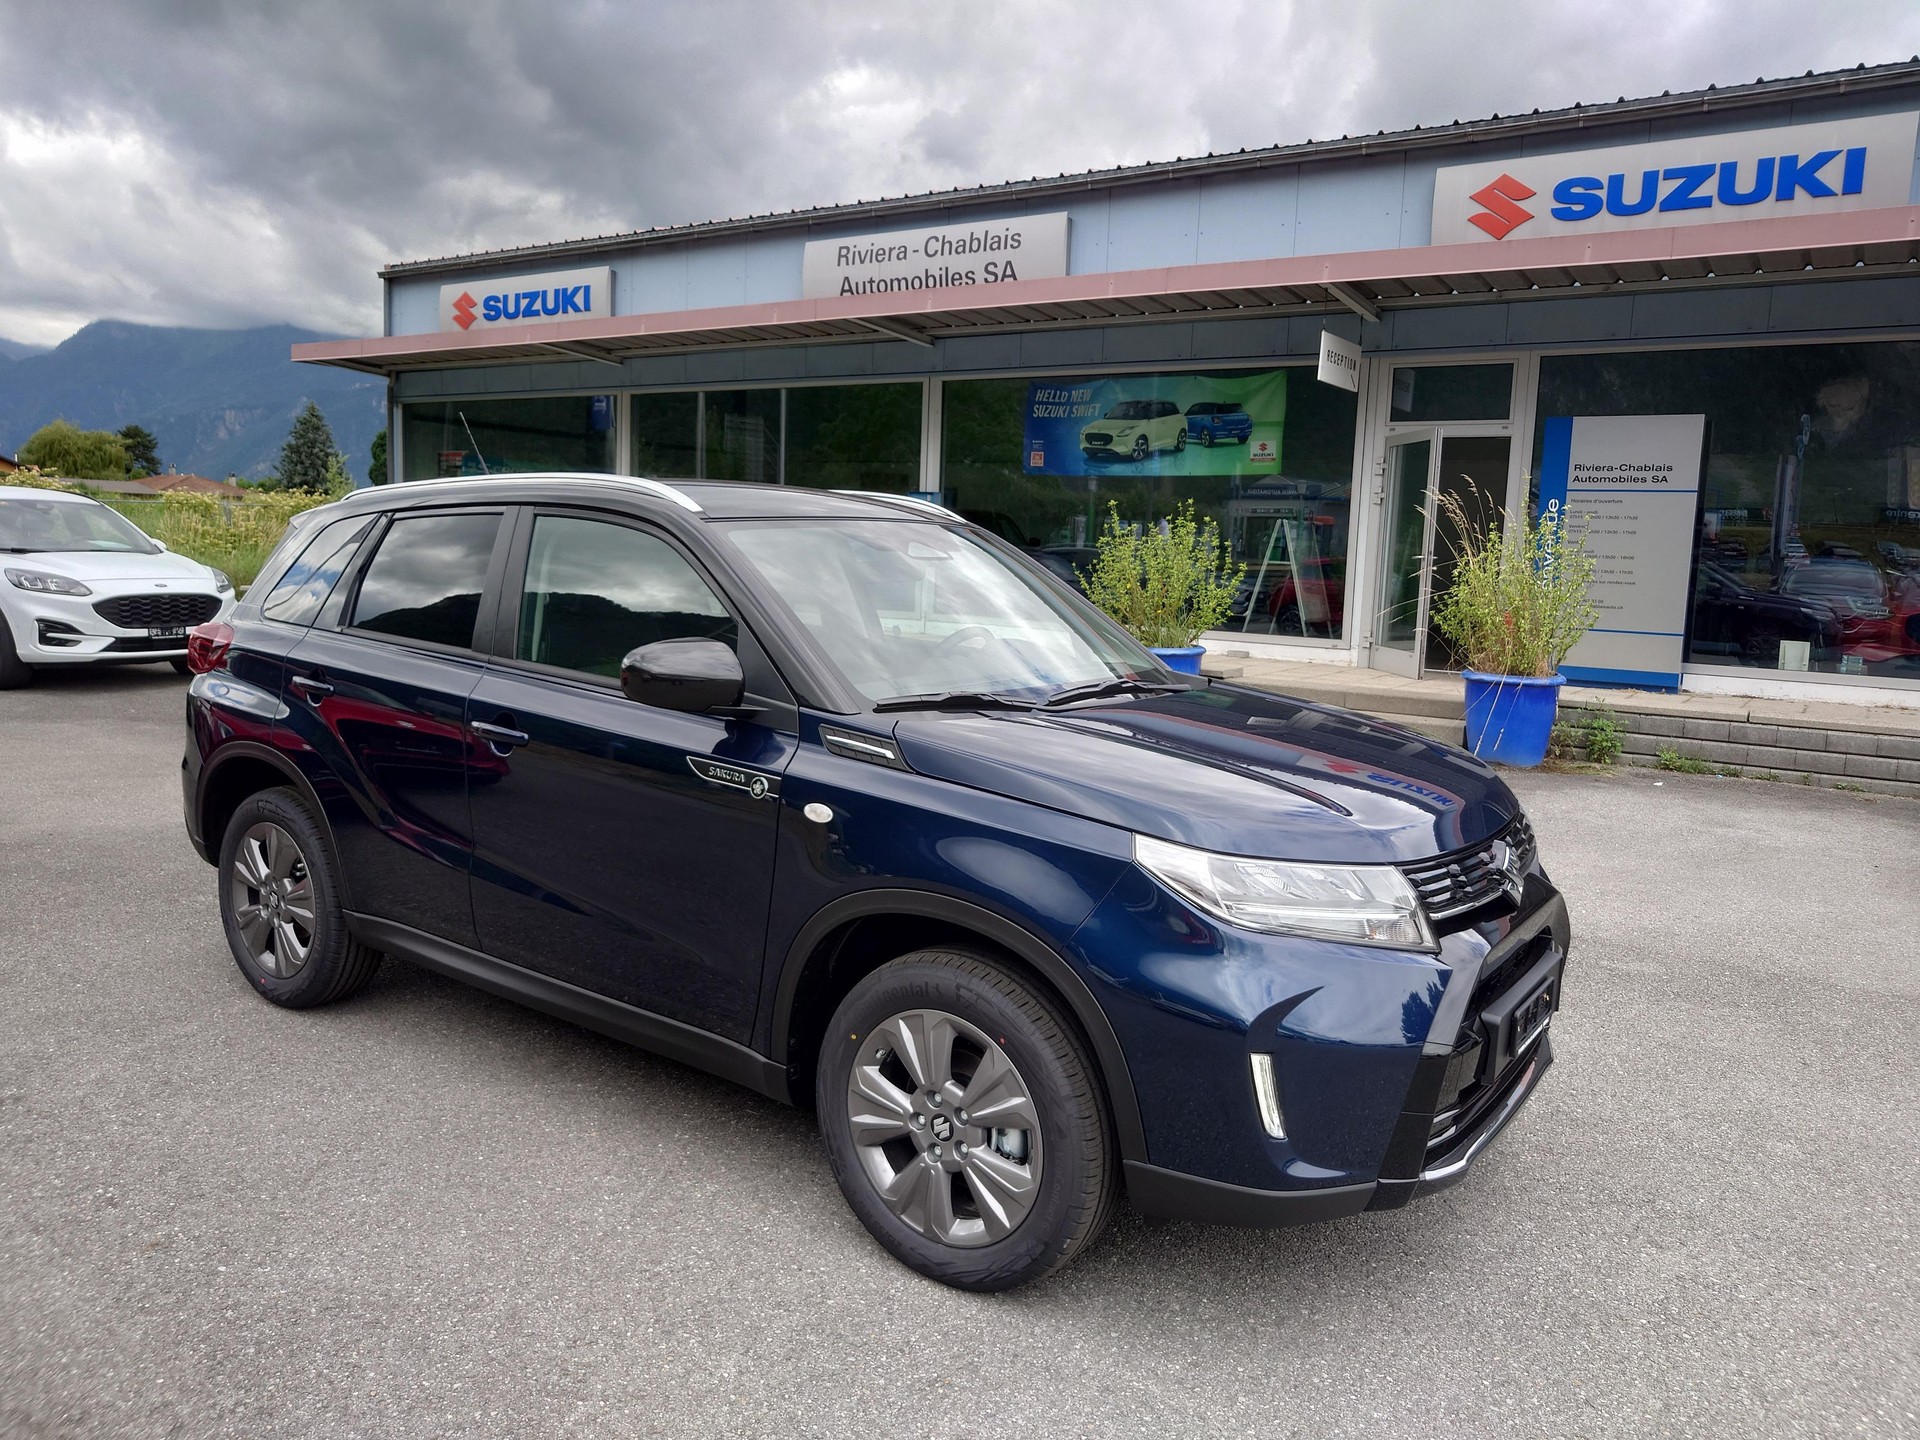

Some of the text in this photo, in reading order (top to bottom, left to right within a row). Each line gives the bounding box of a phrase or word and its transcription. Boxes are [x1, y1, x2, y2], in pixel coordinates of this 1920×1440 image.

[1550, 146, 1867, 222] SUZUKI
[839, 260, 1018, 297] Automobiles SA
[482, 285, 592, 322] SUZUKI
[1327, 349, 1357, 372] RECEPTION
[1035, 388, 1093, 403] HELLO NEW
[1032, 403, 1102, 418] SUZUKI SWIFT
[1573, 463, 1674, 472] Riviera-Chablais
[1572, 475, 1669, 483] Automobiles SA
[708, 766, 746, 783] SAKURA
